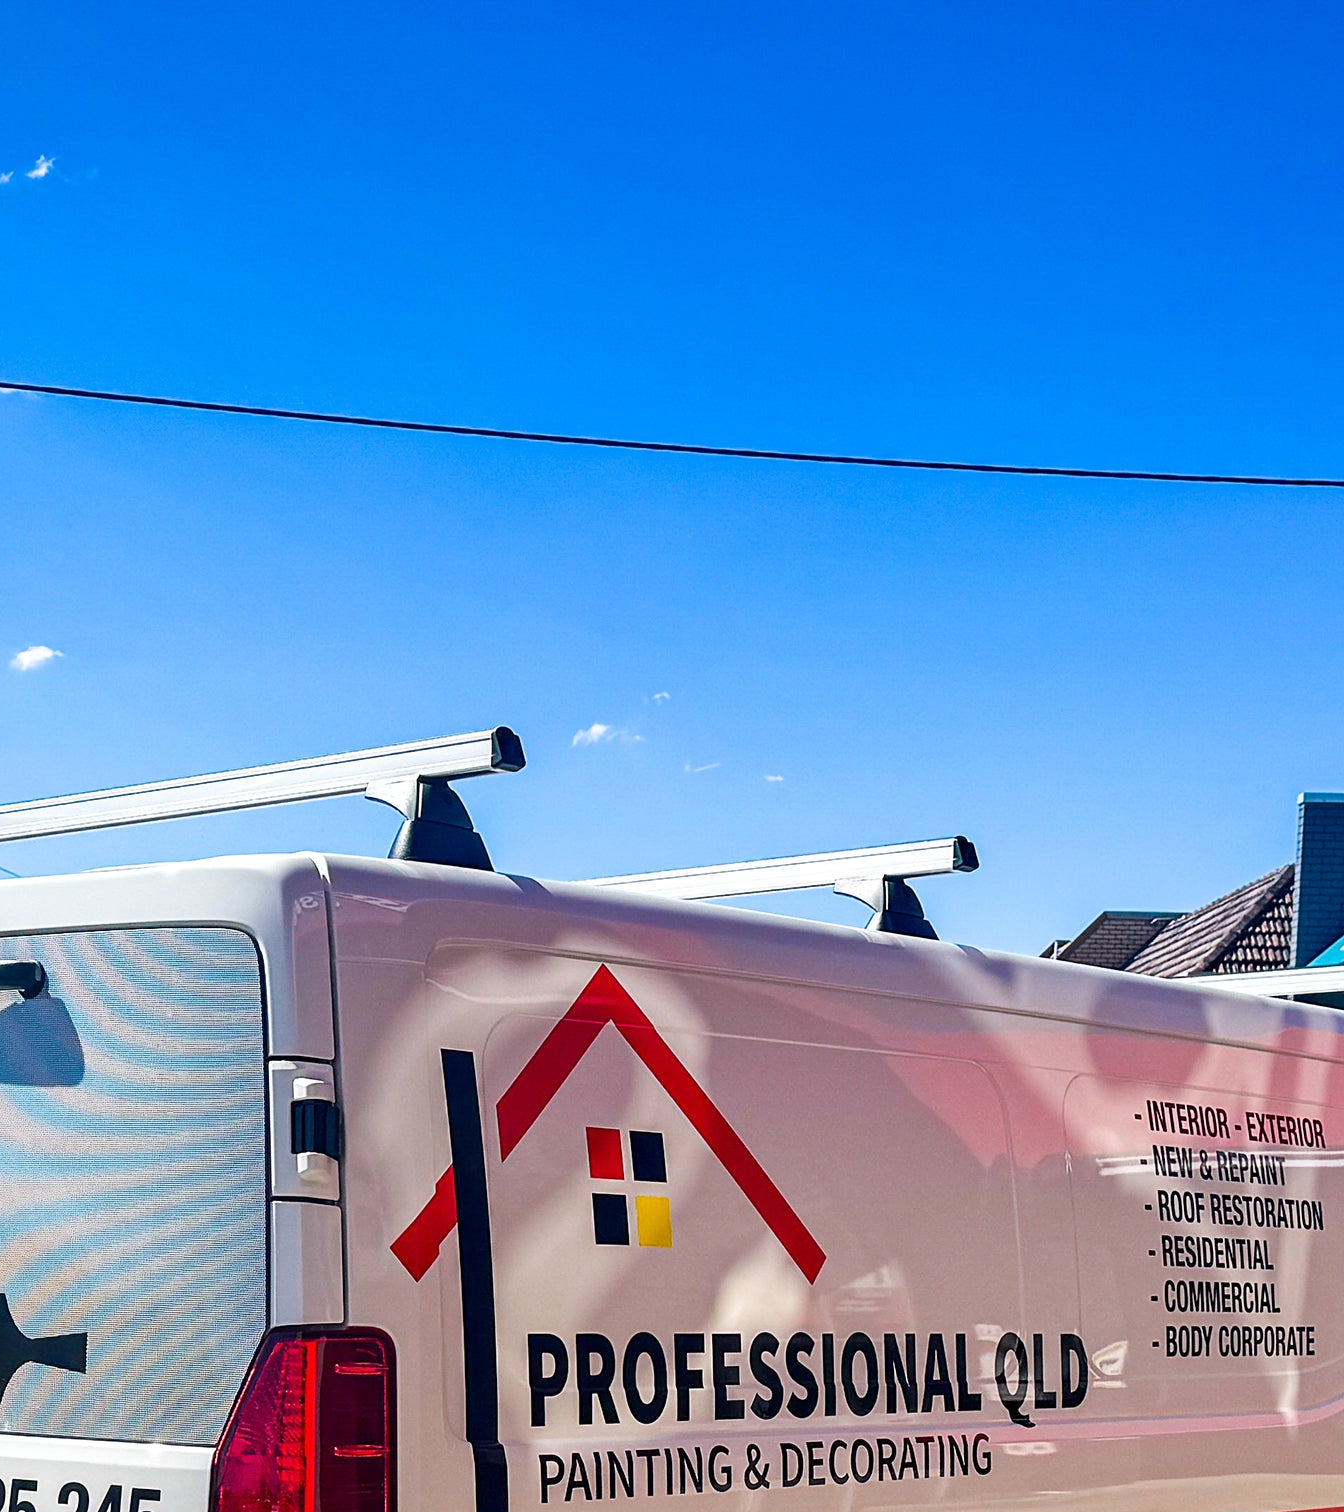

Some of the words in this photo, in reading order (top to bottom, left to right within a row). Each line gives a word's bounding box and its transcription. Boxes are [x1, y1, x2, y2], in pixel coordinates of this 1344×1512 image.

[1146, 1100, 1230, 1139] INTERIOR
[1245, 1111, 1326, 1149] EXTERIOR
[1152, 1144, 1193, 1179] NEW
[1199, 1149, 1213, 1180] &
[1216, 1150, 1286, 1186] REPAINT
[1157, 1190, 1205, 1224] ROOF
[1209, 1193, 1324, 1231] RESTORATION
[1161, 1235, 1274, 1270] RESIDENTIAL
[1164, 1280, 1281, 1313] COMMERCIAL
[1166, 1325, 1213, 1357] BODY
[1219, 1325, 1315, 1357] CORPORATE
[528, 1331, 983, 1428] PROFESSIONAL
[995, 1331, 1089, 1428] QLD
[539, 1443, 733, 1504] PAINTING
[745, 1452, 771, 1491] &
[782, 1433, 992, 1489] DECORATING
